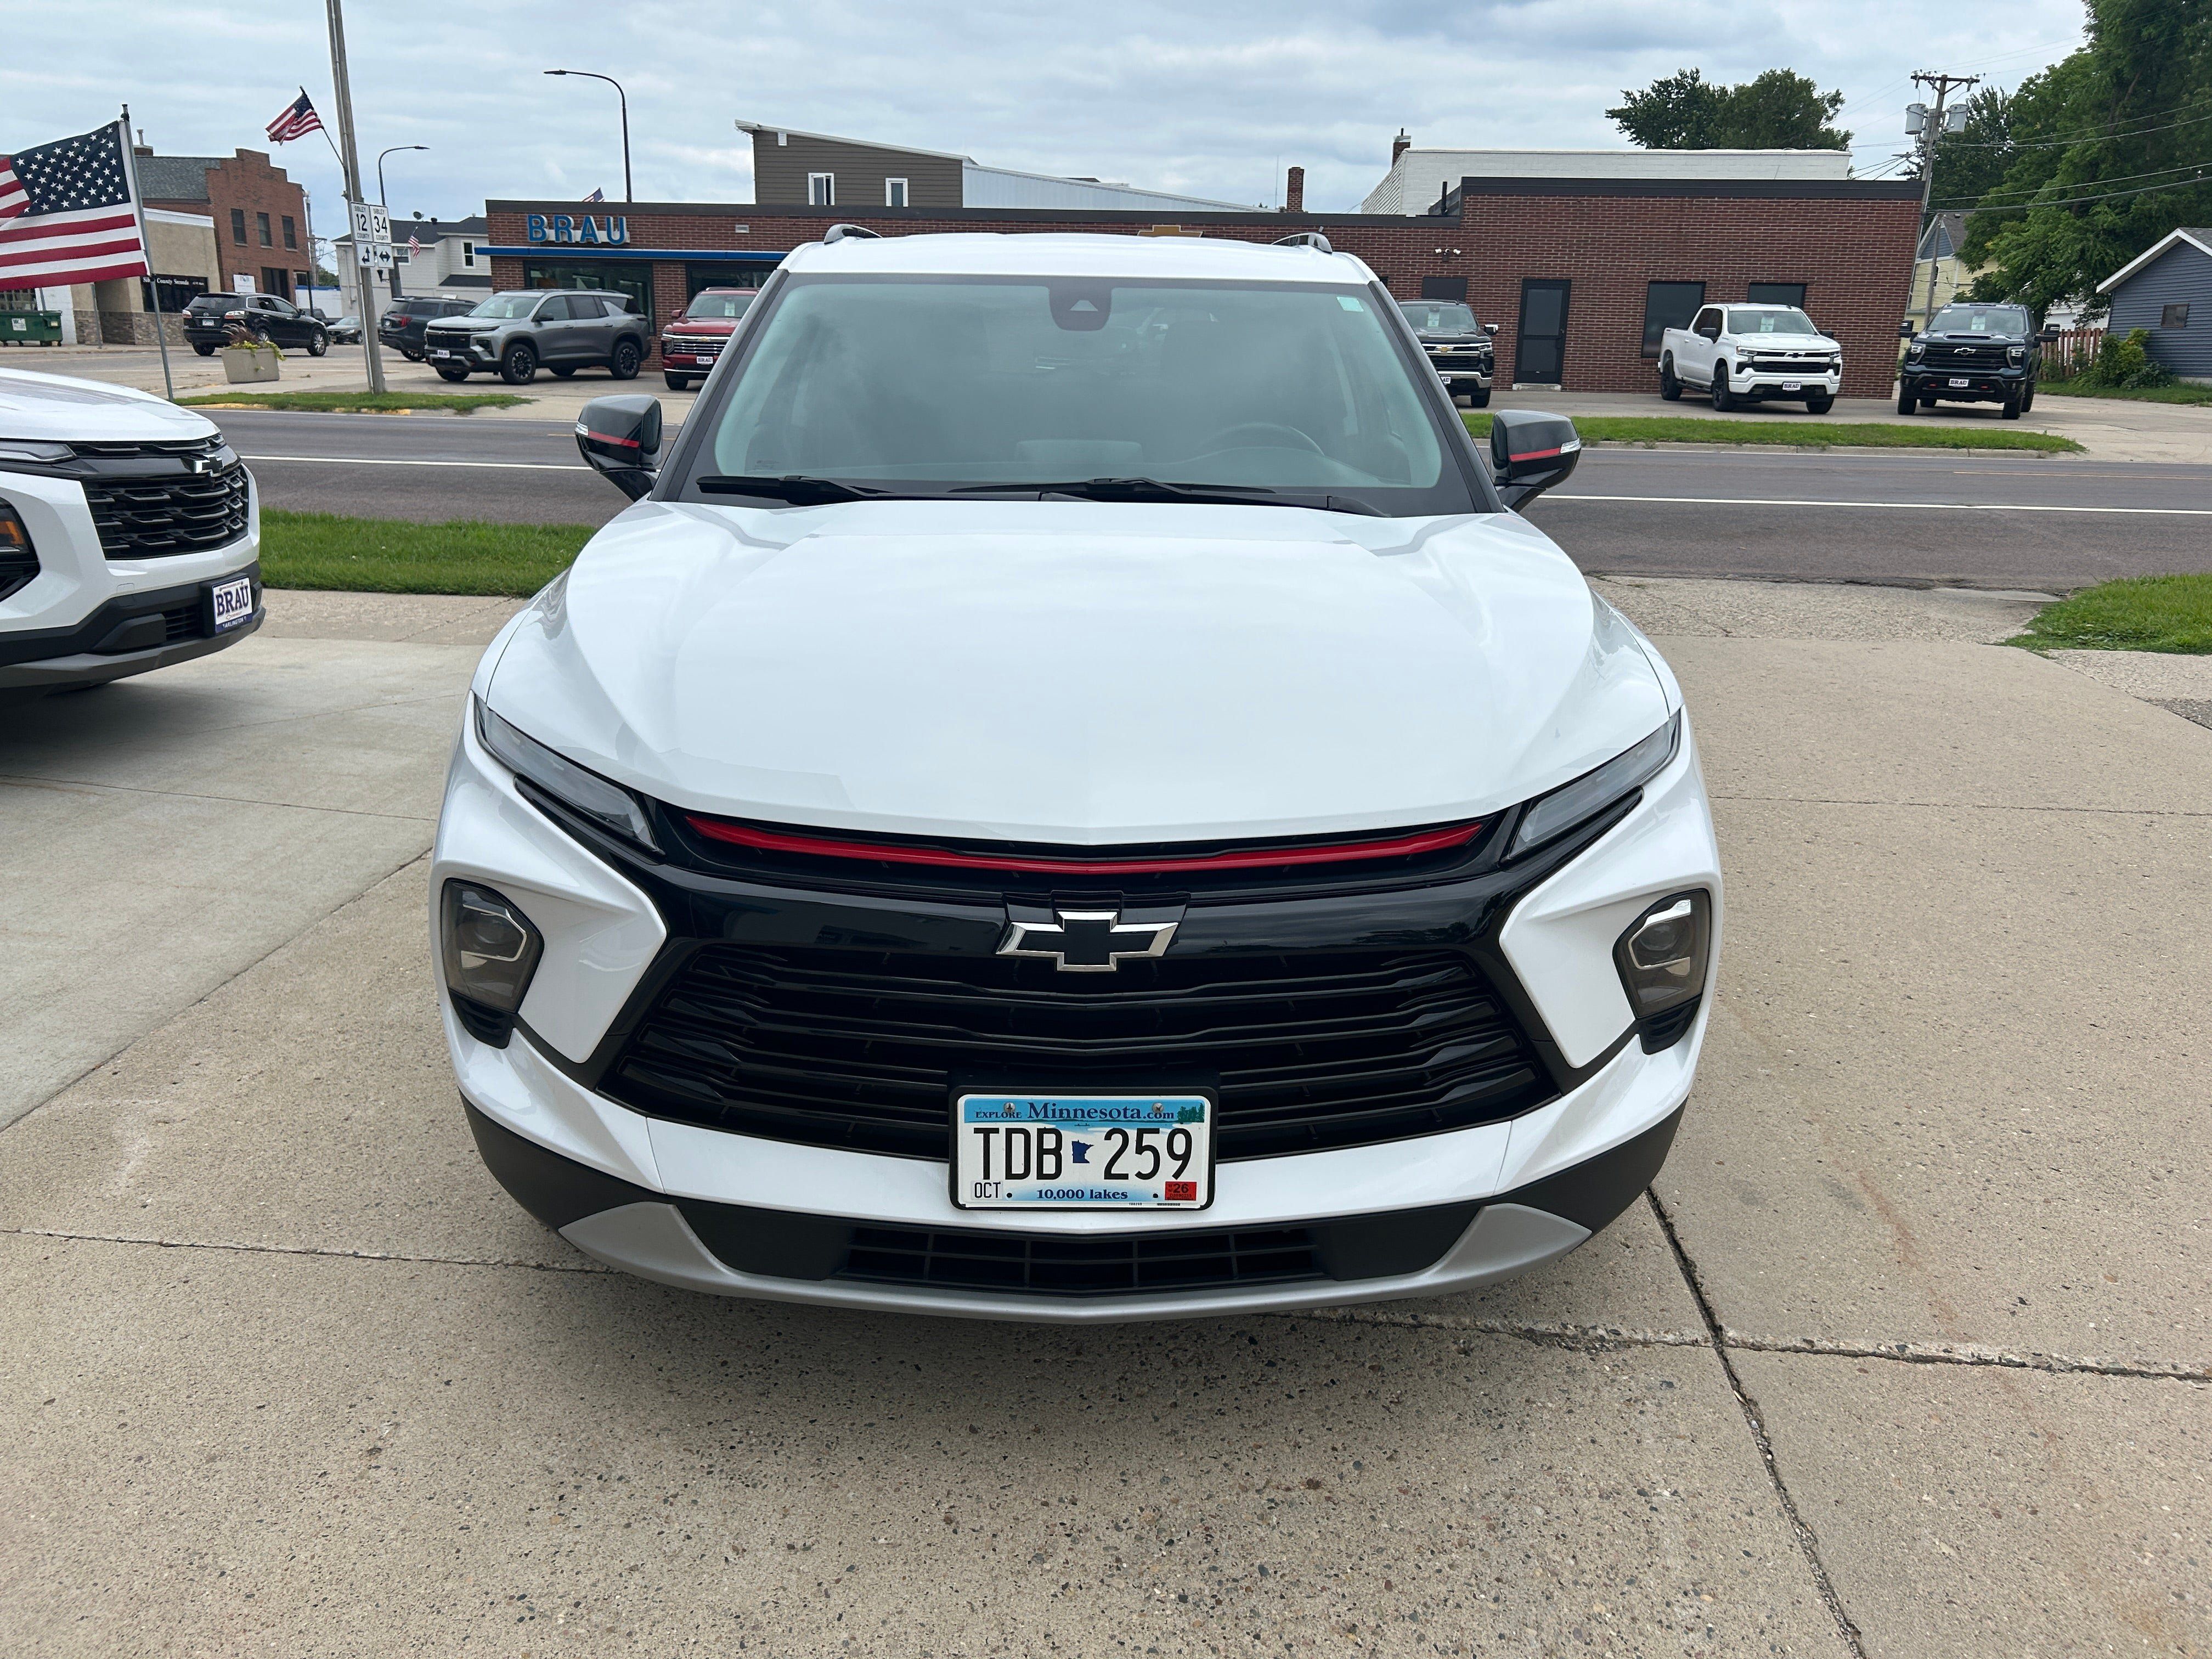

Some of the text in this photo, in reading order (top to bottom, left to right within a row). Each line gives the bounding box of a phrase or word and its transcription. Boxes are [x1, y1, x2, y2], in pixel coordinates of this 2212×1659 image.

[356, 213, 368, 232] 12
[374, 216, 387, 233] 34
[527, 215, 627, 245] BRAU
[216, 585, 249, 617] BRAU
[974, 1127, 1193, 1180] TDB 259
[974, 1182, 1001, 1198] OCT
[1173, 1183, 1189, 1193] 26
[1036, 1189, 1128, 1200] 10,000 lakes
